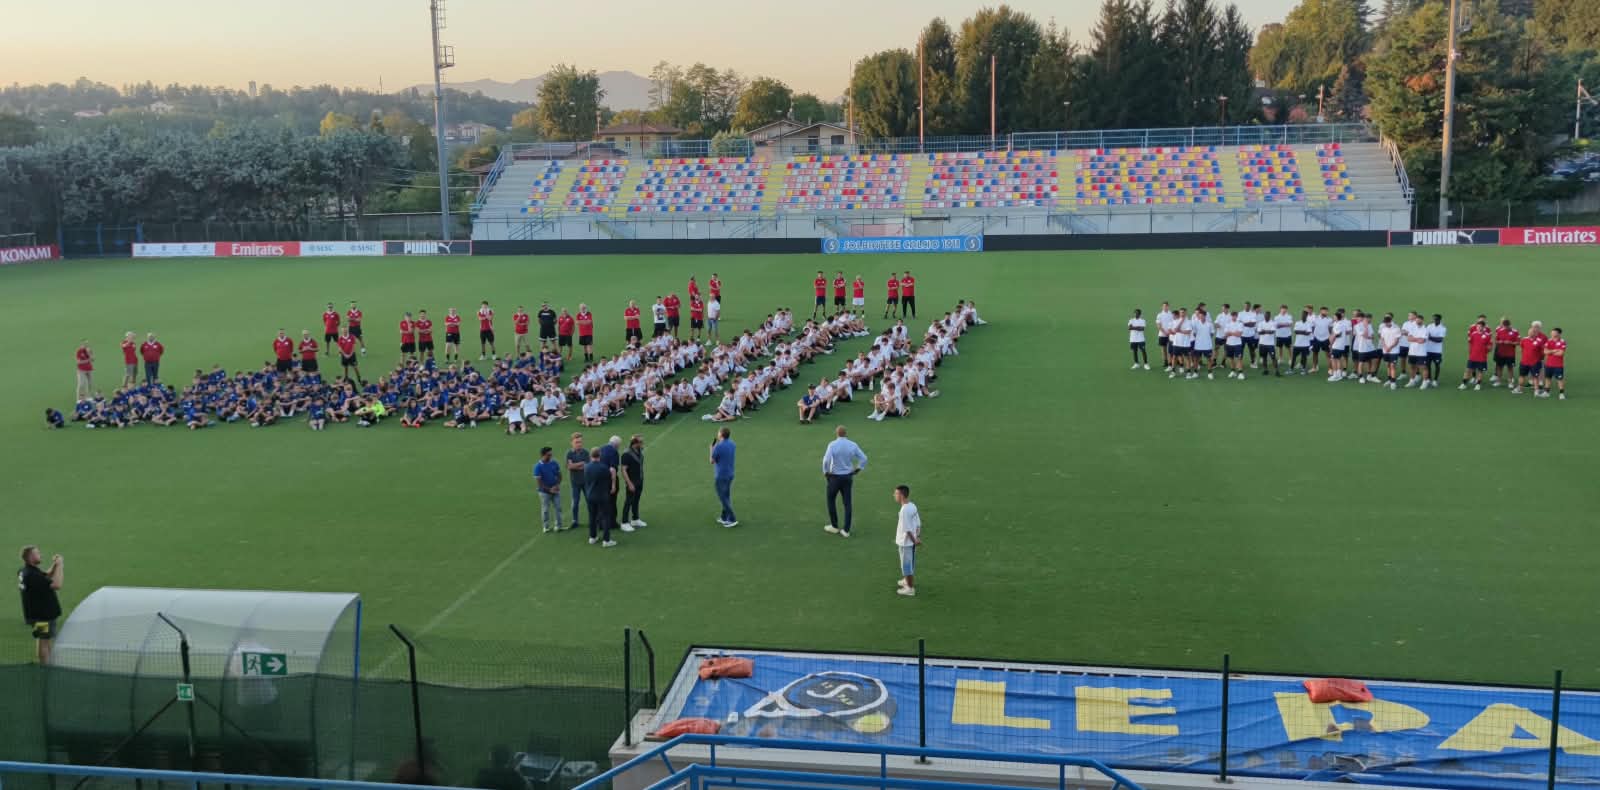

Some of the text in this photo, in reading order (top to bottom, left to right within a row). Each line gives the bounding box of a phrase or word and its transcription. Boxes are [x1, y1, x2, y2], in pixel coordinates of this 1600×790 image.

[903, 239, 940, 250] CALCIO
[1412, 230, 1457, 245] PUMA
[1523, 229, 1597, 245] Emirates
[0, 247, 51, 263] KONAMI
[231, 243, 284, 256] Emirates
[403, 241, 438, 254] PUMA
[952, 679, 1179, 735] LE
